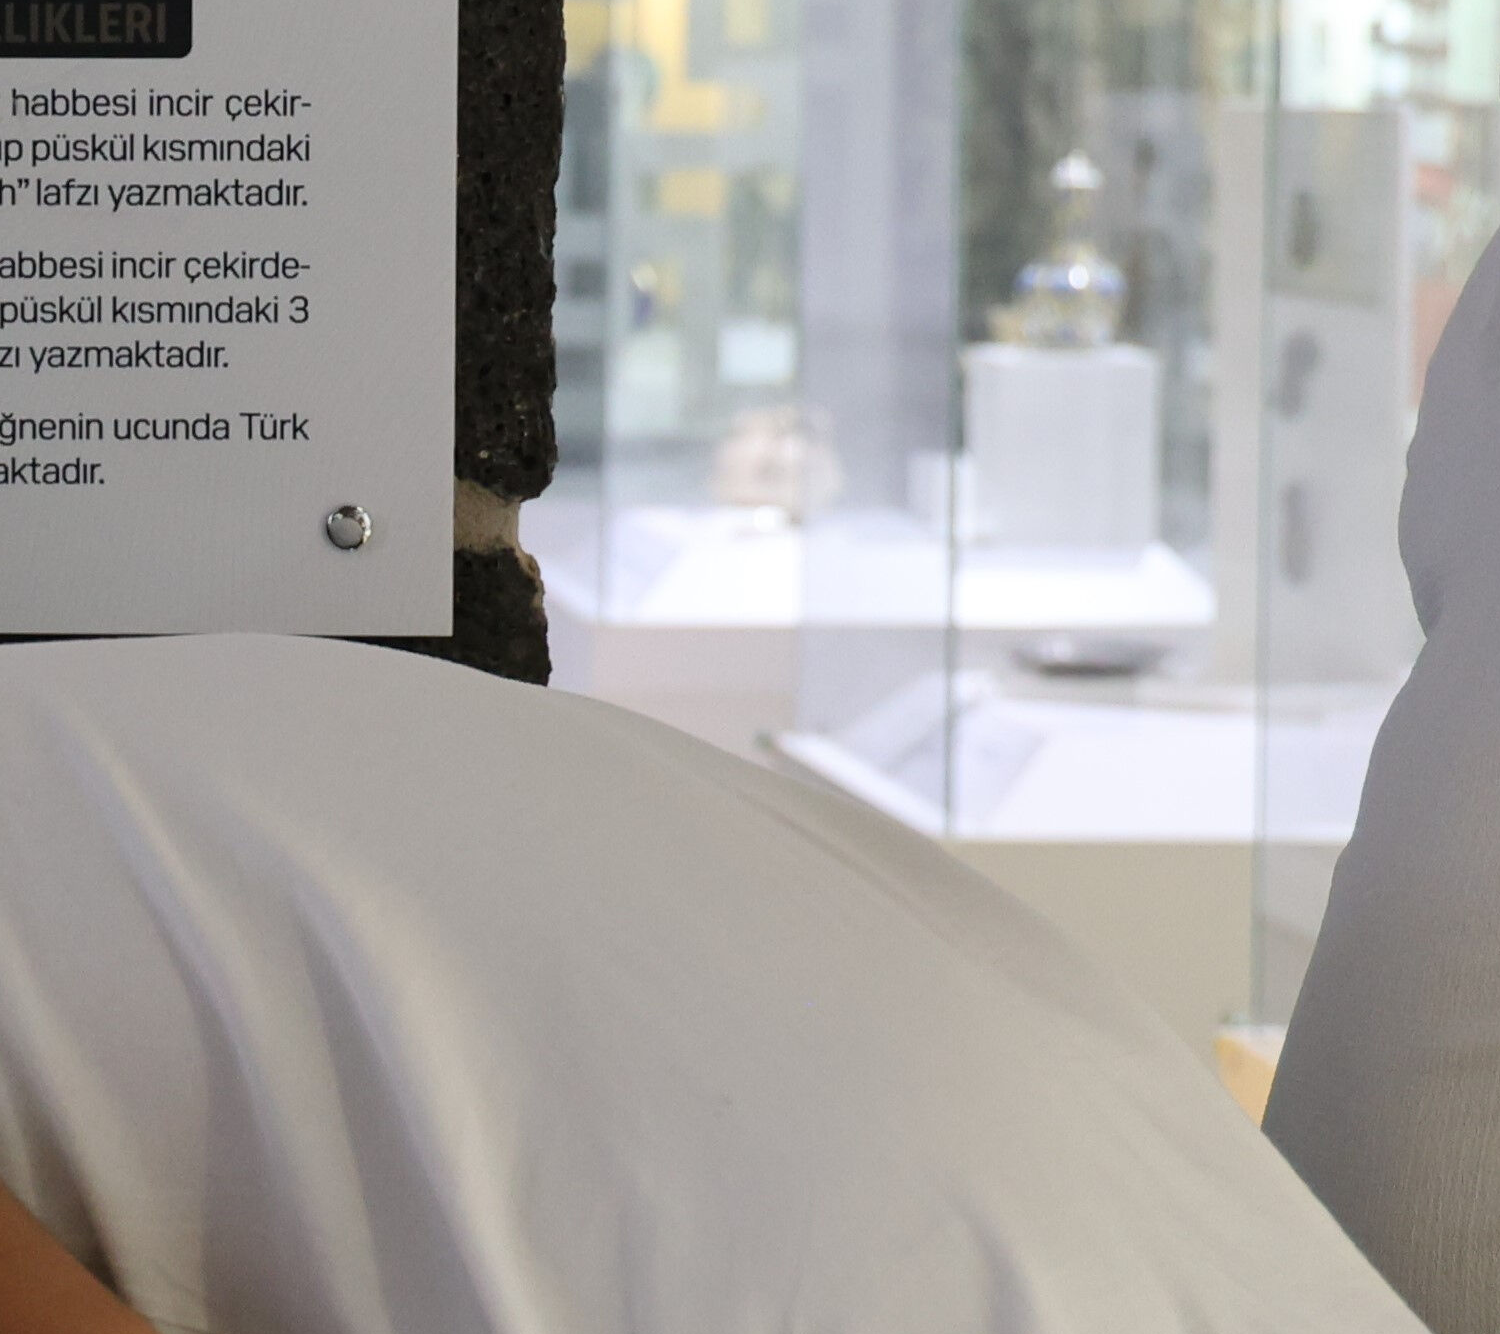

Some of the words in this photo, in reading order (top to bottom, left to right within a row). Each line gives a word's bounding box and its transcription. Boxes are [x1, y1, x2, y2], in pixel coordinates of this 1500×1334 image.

[11, 87, 137, 118] habbesi
[148, 87, 215, 118] incir
[224, 88, 312, 123] çekir-
[31, 132, 135, 168] püskül
[142, 132, 311, 163] kısmındaki
[36, 177, 99, 207] lafzı
[106, 177, 308, 214] yazmaktadır.
[111, 250, 178, 280] incir
[183, 250, 311, 285] çekirde-
[113, 412, 231, 442] ucunda
[238, 411, 310, 441] Türk
